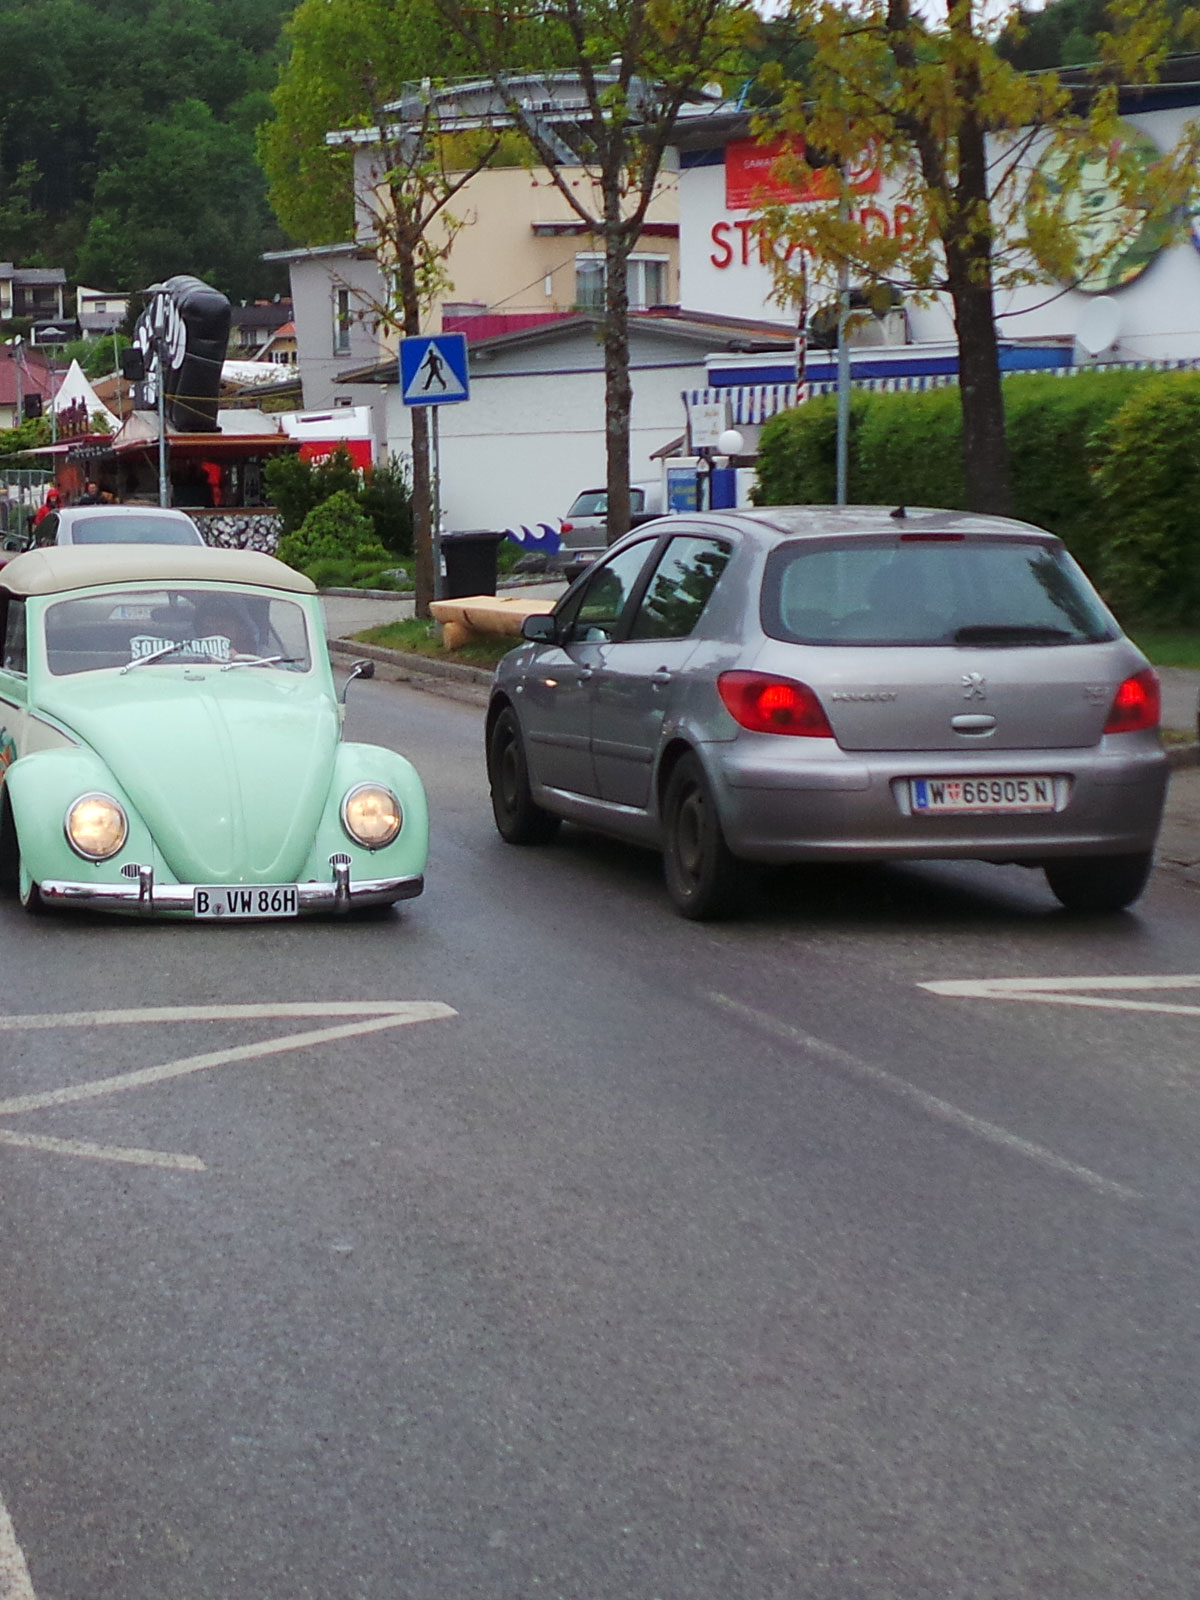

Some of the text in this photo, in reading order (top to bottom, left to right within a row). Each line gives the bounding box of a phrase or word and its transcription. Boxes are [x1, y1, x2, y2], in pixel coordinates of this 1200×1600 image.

[930, 778, 1048, 804] W 66905 N
[197, 889, 295, 913] B VW 86H
